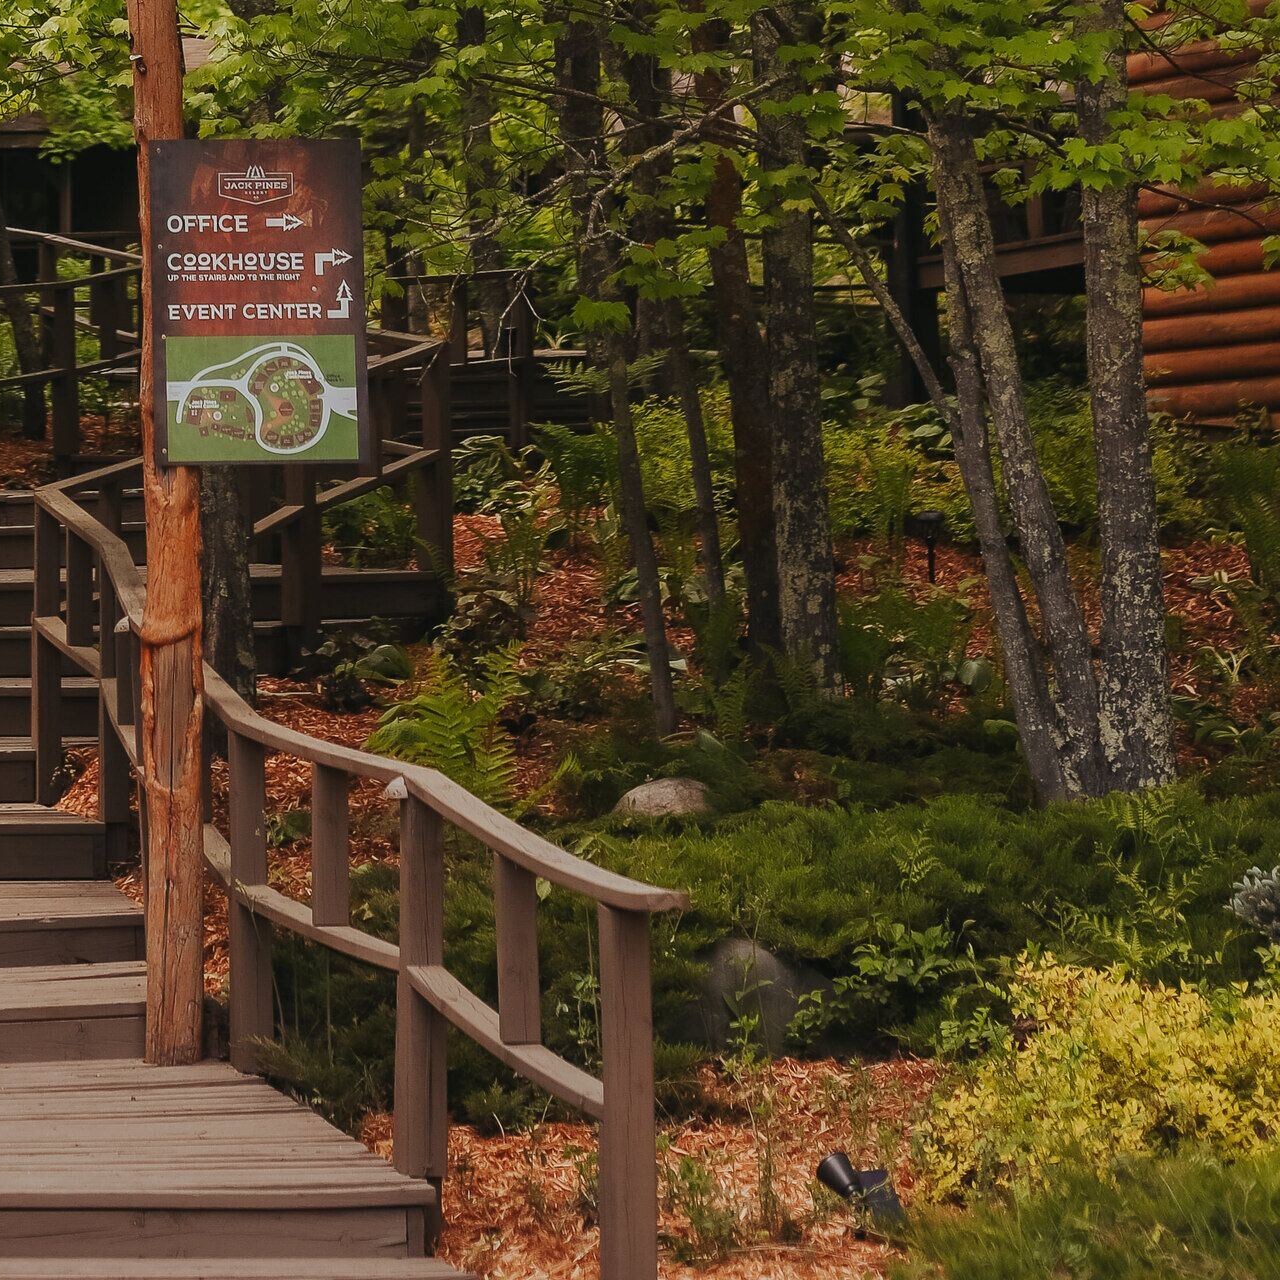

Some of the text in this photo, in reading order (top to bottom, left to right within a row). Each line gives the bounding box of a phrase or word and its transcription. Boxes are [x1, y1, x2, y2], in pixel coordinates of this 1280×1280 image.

[223, 181, 288, 190] JACK PINES
[166, 214, 249, 233] OFFICE
[166, 252, 305, 271] COOKHOUSE
[167, 273, 301, 282] UP THE STAIRS AND TO THE RIGHT
[167, 303, 322, 320] EVENT CENTER
